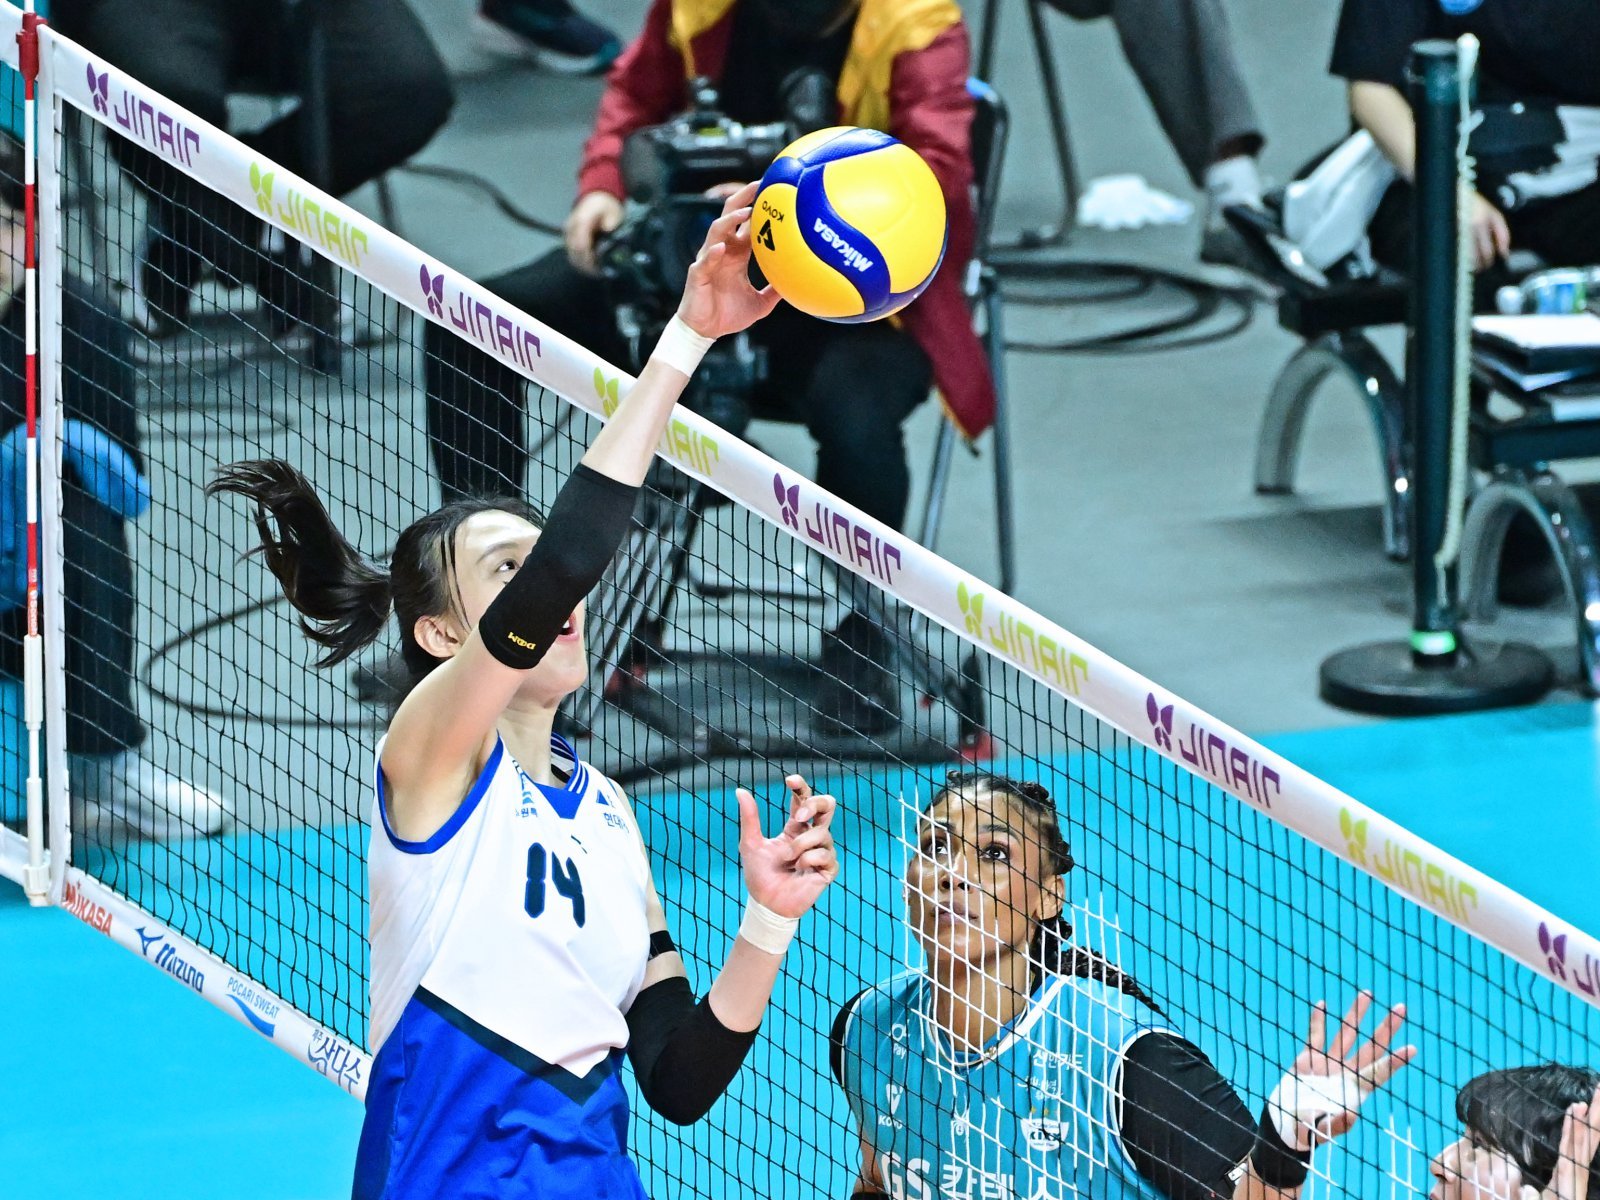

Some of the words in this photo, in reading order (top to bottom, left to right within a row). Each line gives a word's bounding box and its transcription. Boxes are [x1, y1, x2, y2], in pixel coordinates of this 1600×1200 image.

[762, 200, 785, 223] KOVO
[524, 842, 585, 928] 14
[227, 976, 256, 1003] POCARI
[253, 994, 280, 1019] SWEAT
